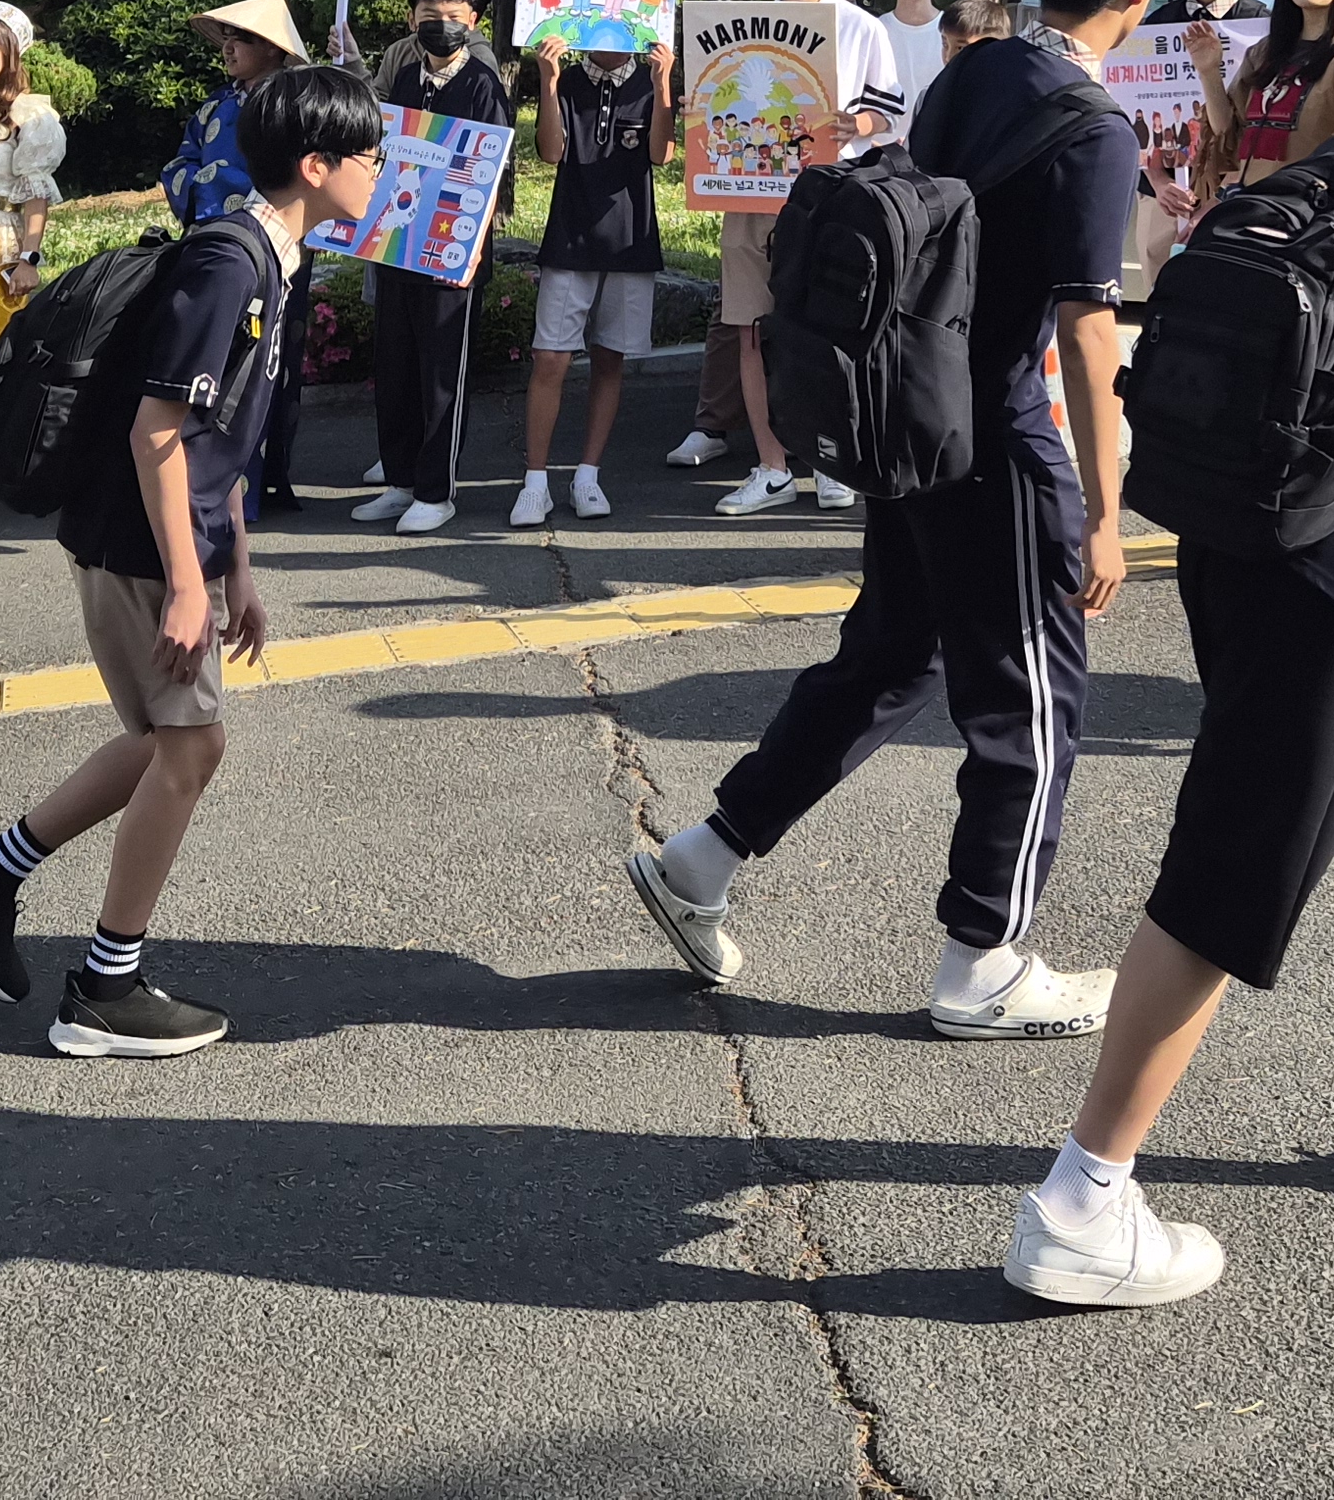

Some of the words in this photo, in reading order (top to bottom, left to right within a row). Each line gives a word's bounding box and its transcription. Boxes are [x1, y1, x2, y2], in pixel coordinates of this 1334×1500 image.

[696, 17, 826, 55] HARMONY
[1106, 63, 1178, 83] 세계시민의
[758, 181, 787, 192] 친구는
[1023, 1013, 1095, 1036] crocs
